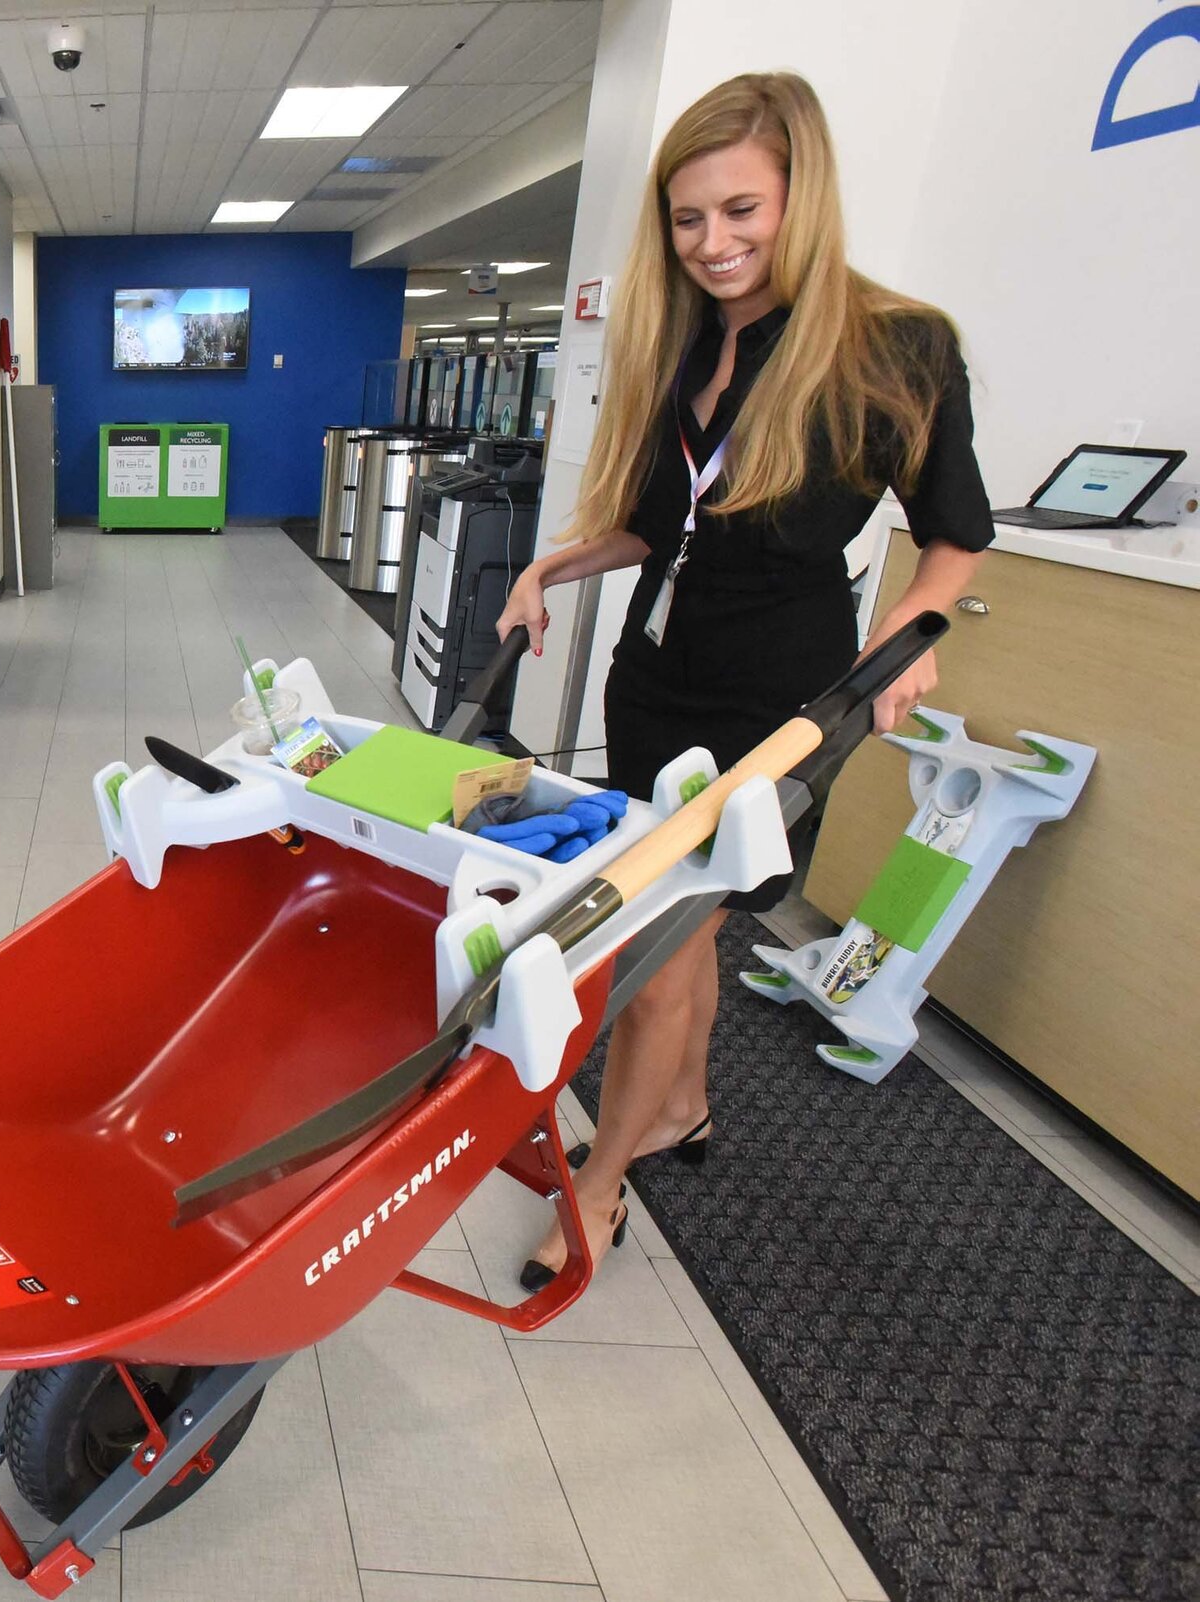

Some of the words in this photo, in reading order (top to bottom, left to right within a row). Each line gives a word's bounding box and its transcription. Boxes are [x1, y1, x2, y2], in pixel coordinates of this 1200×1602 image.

[10, 355, 19, 364] ED
[821, 964, 841, 989] BURRO
[837, 939, 859, 965] BUDDY
